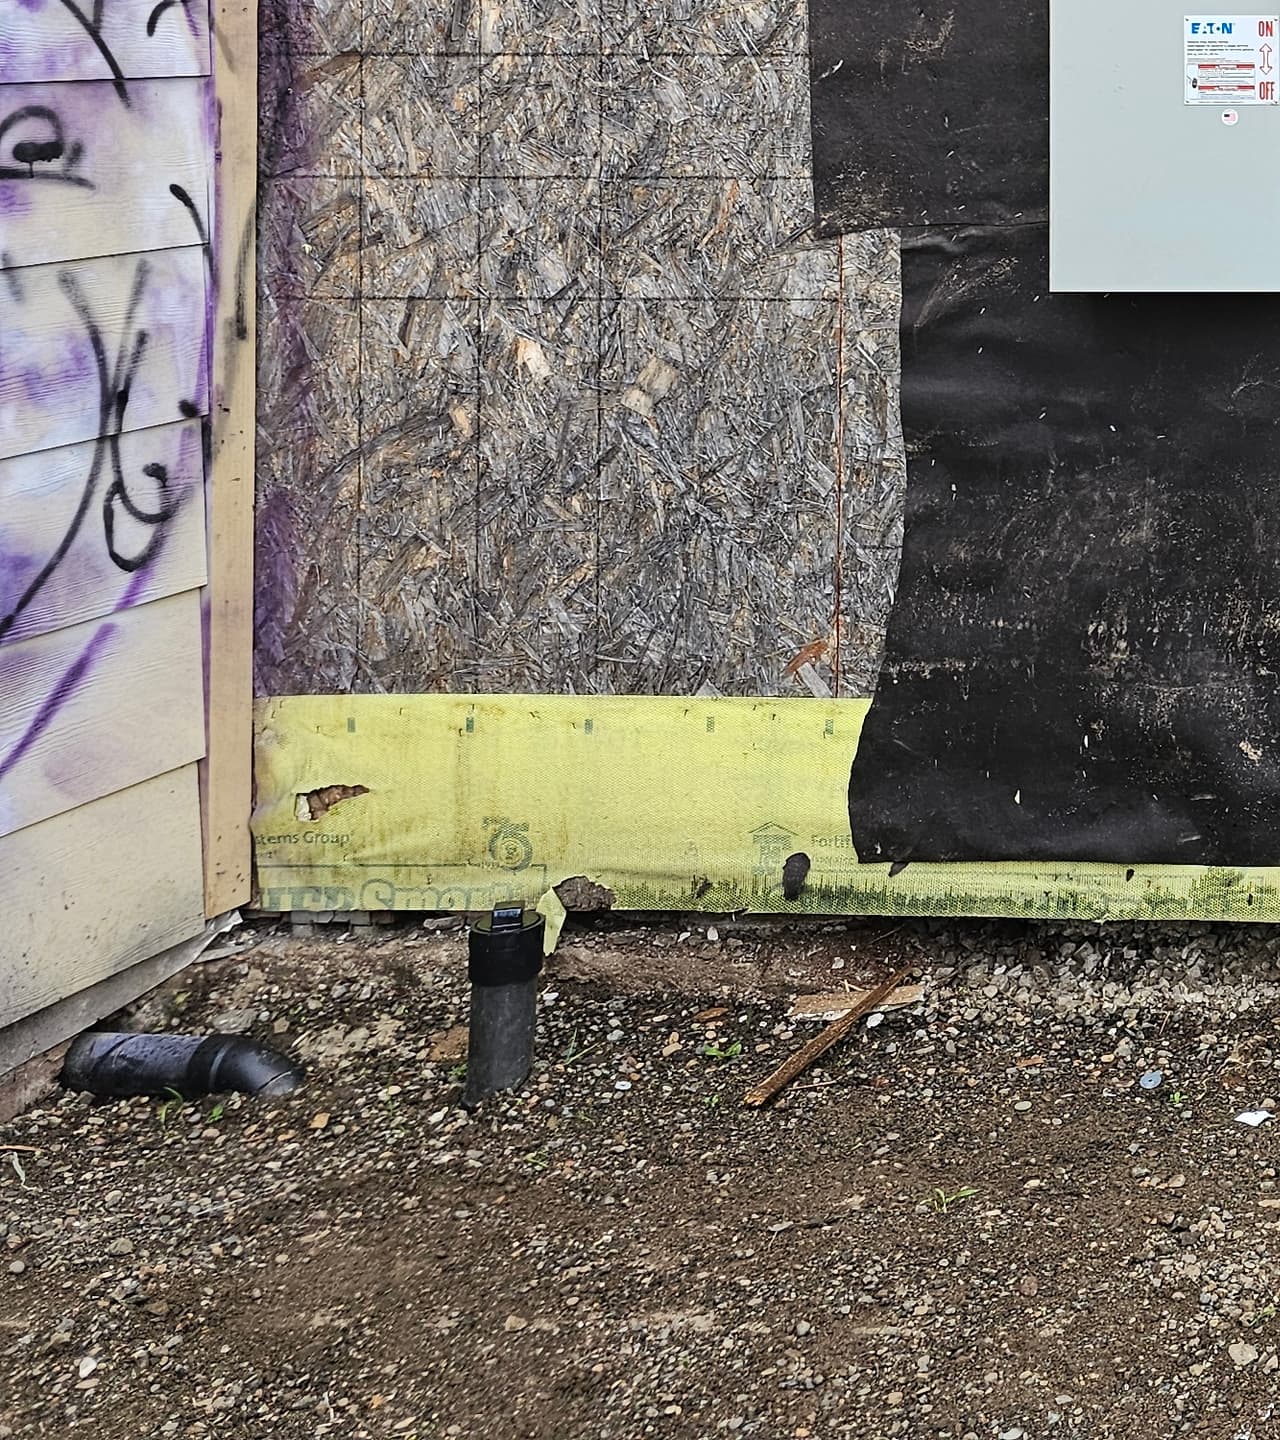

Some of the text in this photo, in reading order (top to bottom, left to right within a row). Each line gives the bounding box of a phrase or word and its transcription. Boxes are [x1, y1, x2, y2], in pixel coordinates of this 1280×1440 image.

[1258, 21, 1273, 37] ON
[1259, 81, 1275, 100] OFF
[303, 830, 350, 847] Group
